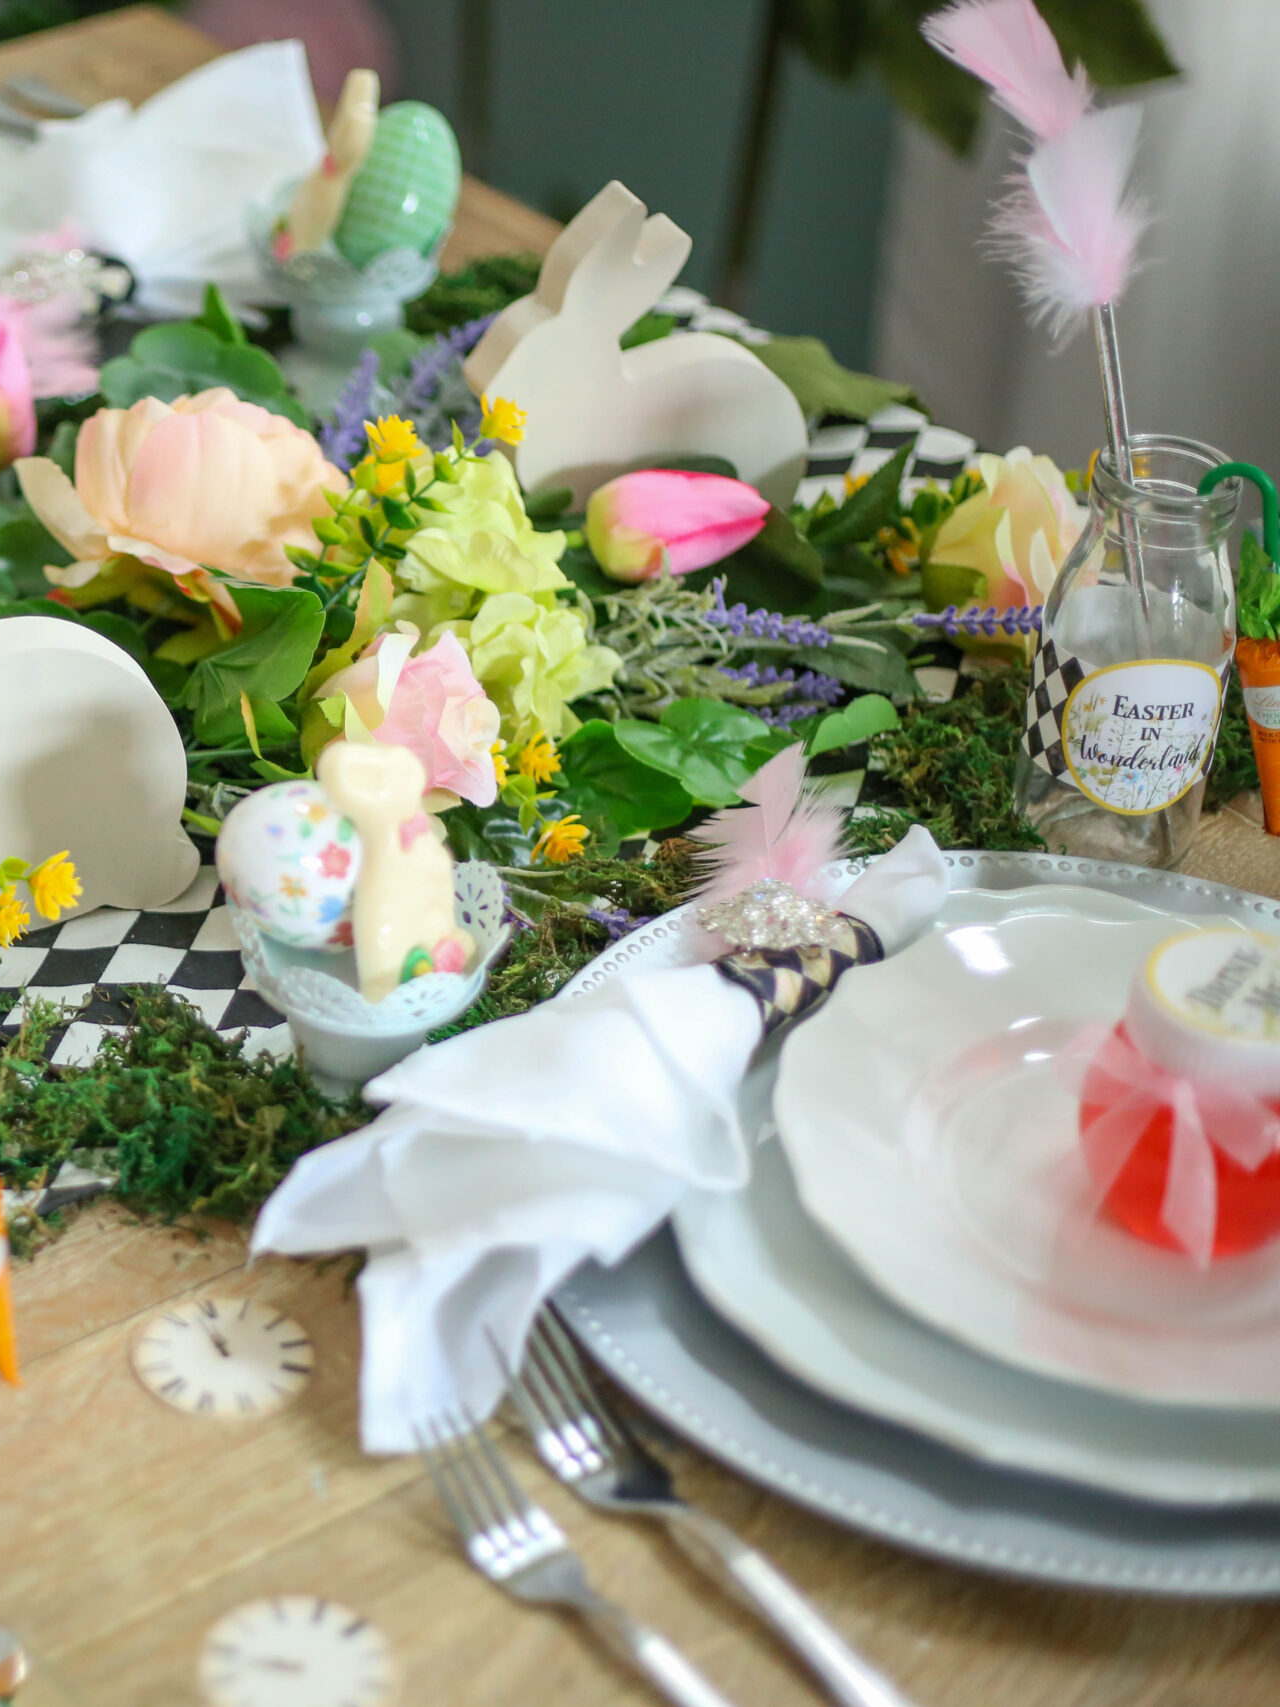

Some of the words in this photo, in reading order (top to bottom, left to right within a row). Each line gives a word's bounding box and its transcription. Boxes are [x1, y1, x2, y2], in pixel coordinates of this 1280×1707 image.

[1112, 695, 1195, 721] EASTER
[1140, 727, 1162, 741] IN
[1080, 733, 1206, 771] Wonderland
